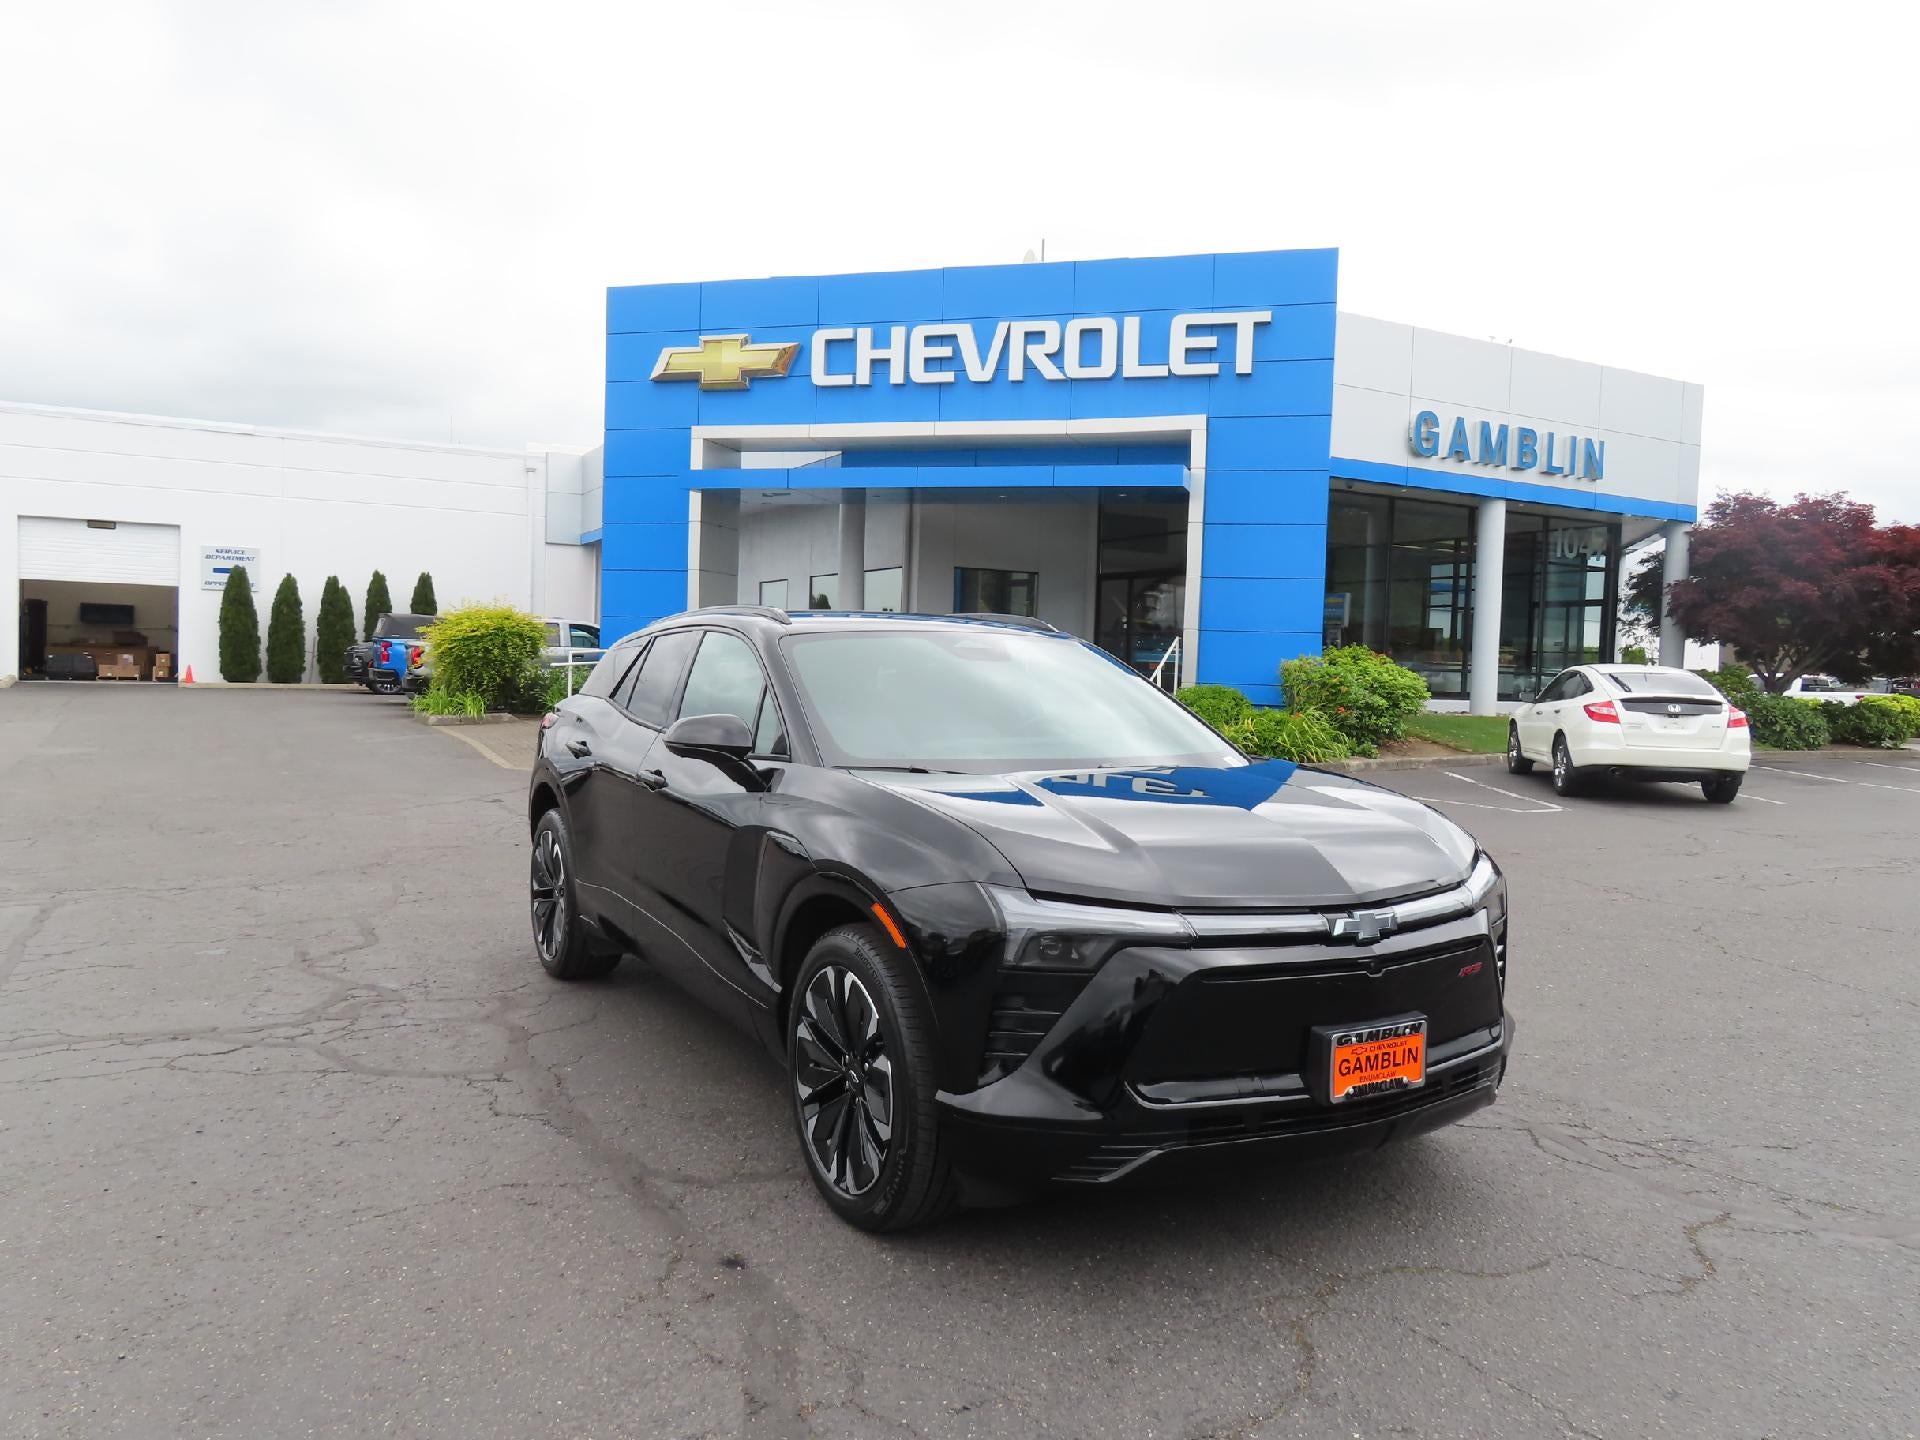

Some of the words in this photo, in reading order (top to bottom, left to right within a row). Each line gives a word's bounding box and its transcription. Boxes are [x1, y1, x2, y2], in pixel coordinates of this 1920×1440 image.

[811, 310, 1273, 386] CHEVROLET
[1408, 410, 1606, 481] GAMBLIN
[1337, 1022, 1422, 1047] GAMBLIN
[1369, 1040, 1408, 1053] CHEVROLET
[1338, 1046, 1419, 1077] GAMBLIN
